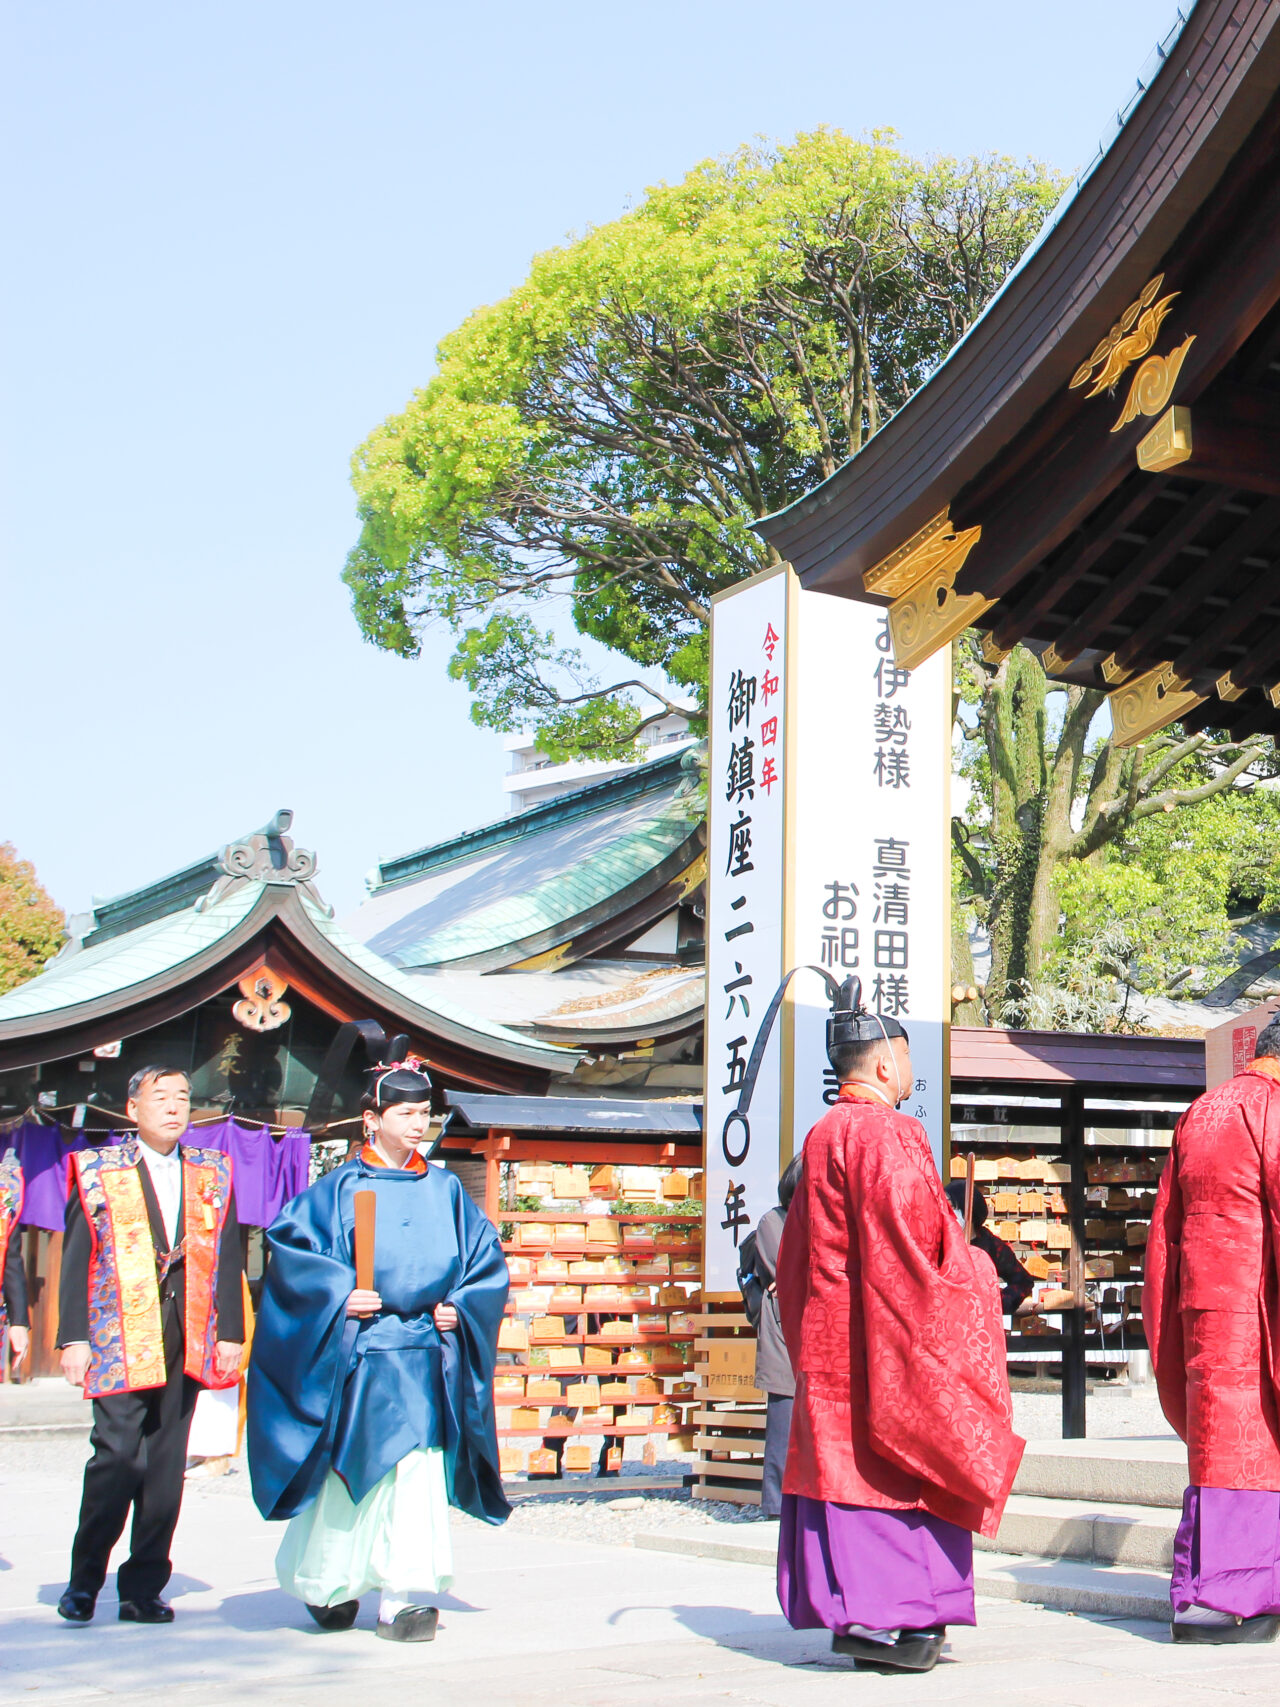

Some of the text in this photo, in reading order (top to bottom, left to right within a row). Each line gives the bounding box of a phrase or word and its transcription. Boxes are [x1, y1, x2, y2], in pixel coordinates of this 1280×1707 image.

[759, 622, 780, 797] 令和四年
[872, 837, 911, 1016] 真清田様
